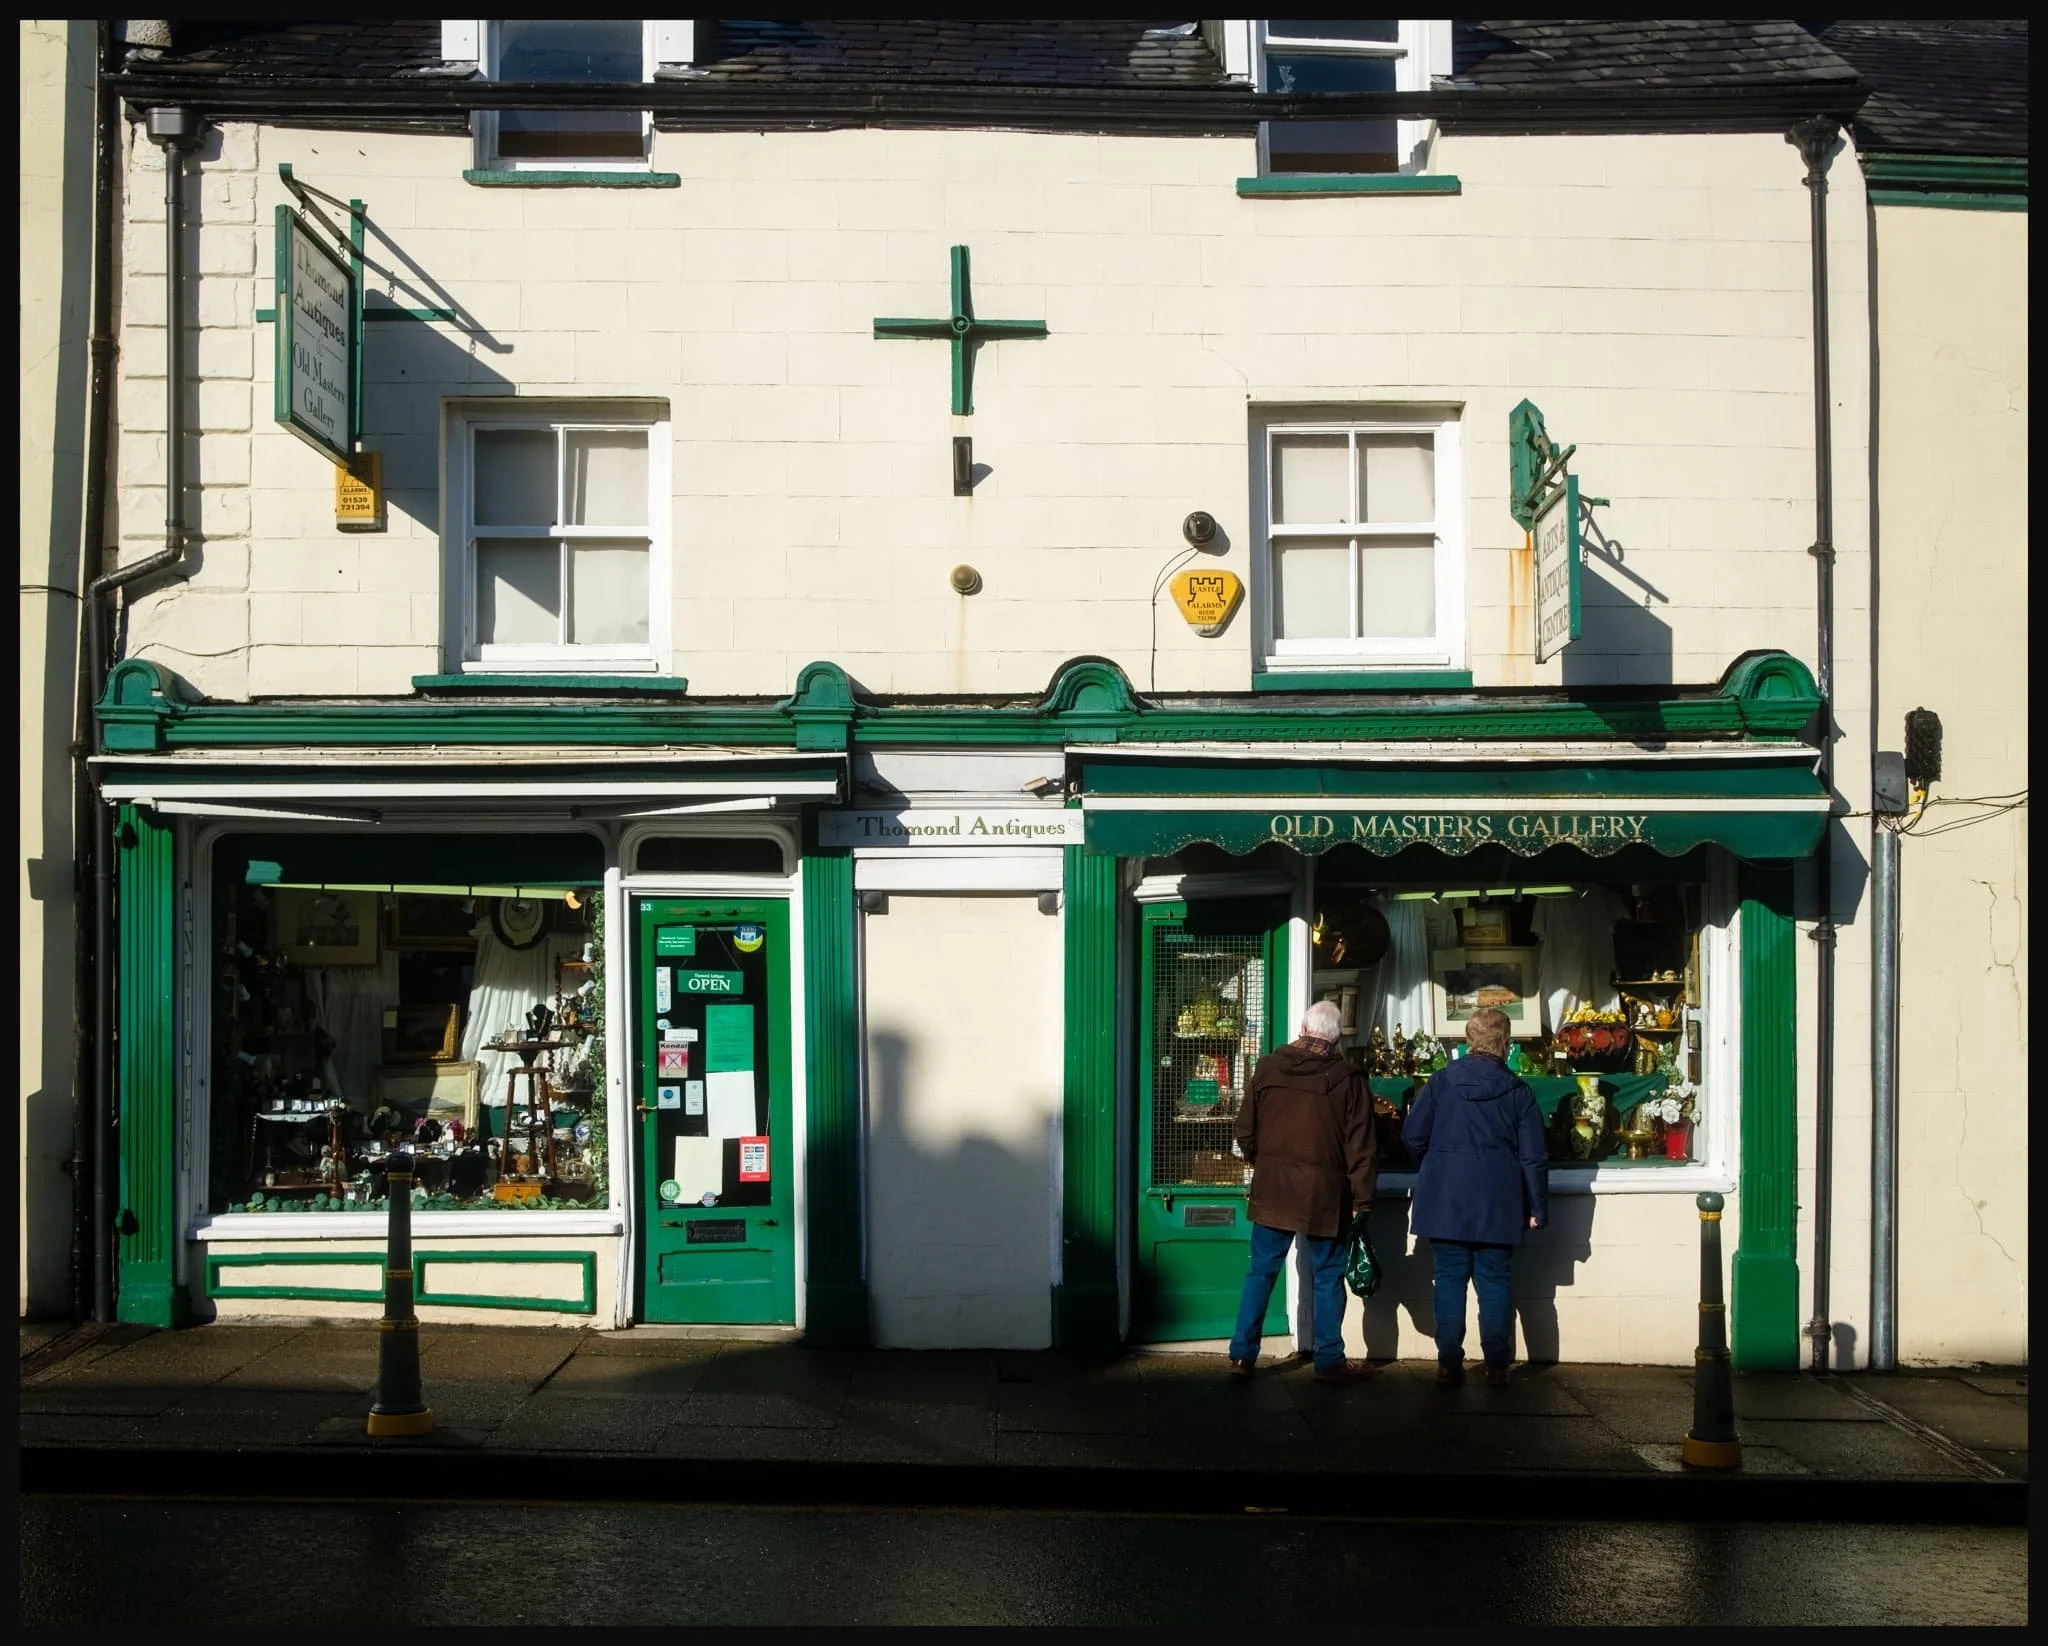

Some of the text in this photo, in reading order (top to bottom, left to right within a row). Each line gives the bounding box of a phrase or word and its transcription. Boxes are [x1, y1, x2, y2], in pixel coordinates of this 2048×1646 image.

[294, 236, 345, 310] Thomond
[294, 280, 346, 347] Antiques
[293, 342, 346, 405] Old Masters
[303, 386, 336, 435] Gallery
[1542, 518, 1566, 562] ARTS &
[1542, 604, 1569, 647] CENTRE
[856, 815, 960, 837] Thomond
[967, 815, 1066, 840] Antiques
[1270, 815, 1649, 838] OLD MASTERS GALLERY
[640, 903, 652, 912] 33
[688, 978, 731, 991] OPEN
